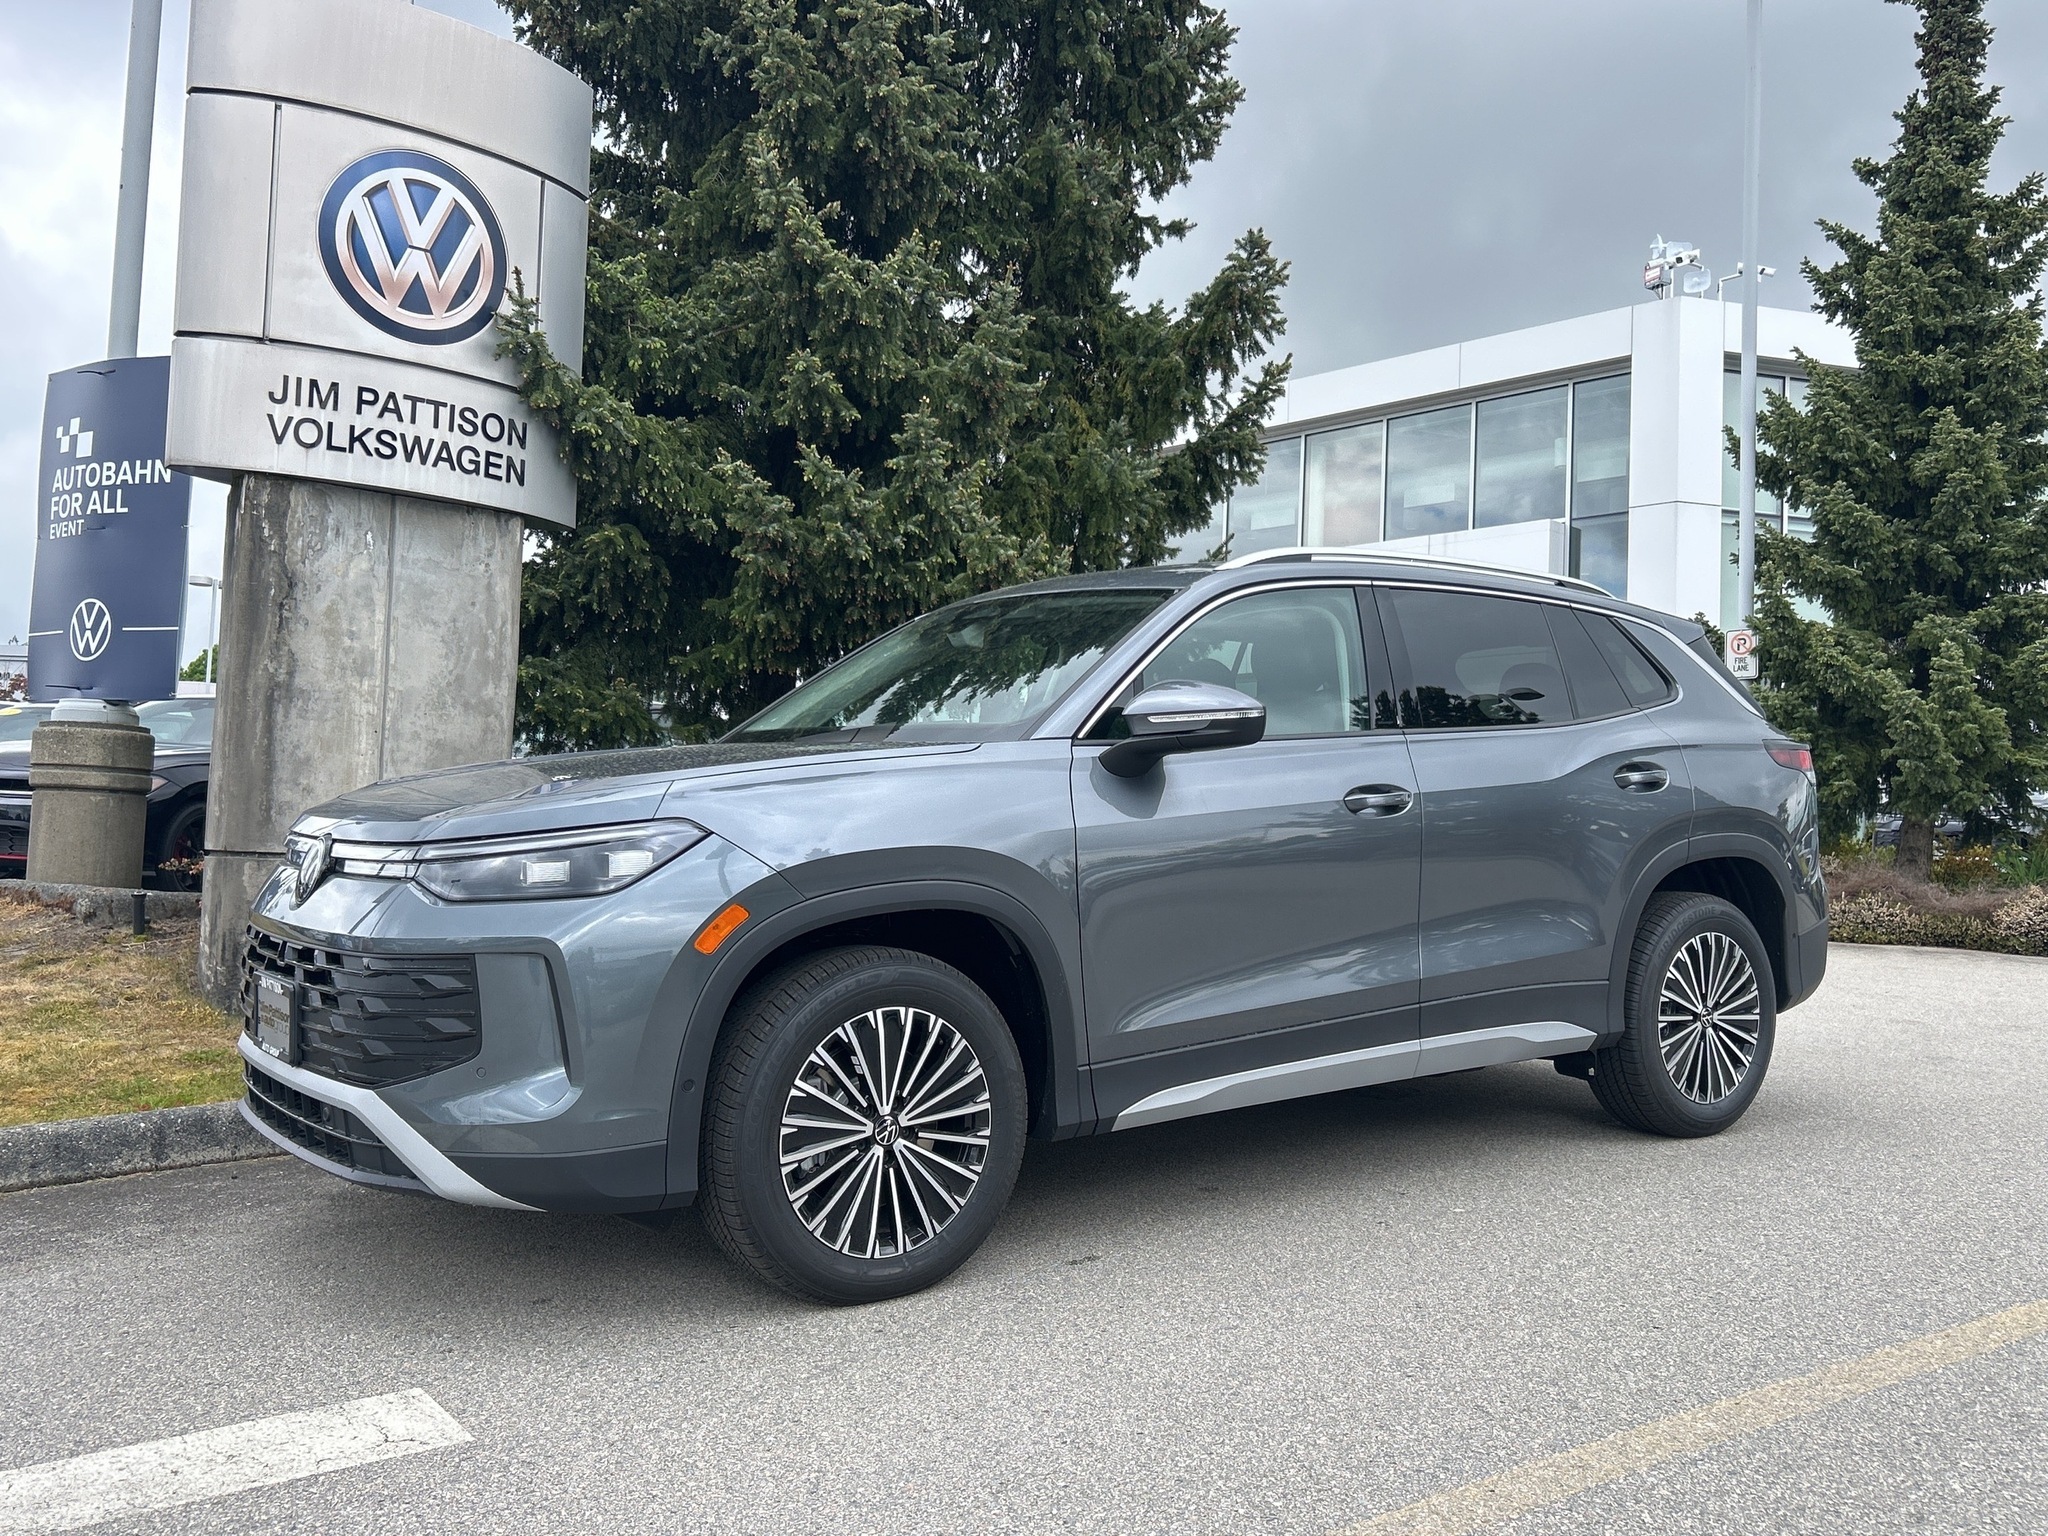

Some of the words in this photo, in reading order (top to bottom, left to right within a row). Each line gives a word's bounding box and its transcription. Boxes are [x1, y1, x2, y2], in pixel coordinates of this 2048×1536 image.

[268, 374, 340, 411] JIM
[356, 385, 528, 450] PATTISON
[267, 413, 527, 487] VOLKSWAGEN
[52, 459, 172, 493] AUTOBAHN
[50, 491, 83, 521] FOR
[86, 488, 129, 515] ALL
[49, 518, 85, 540] EVENT
[1733, 664, 1749, 673] LANE
[1734, 657, 1748, 665] FIRE
